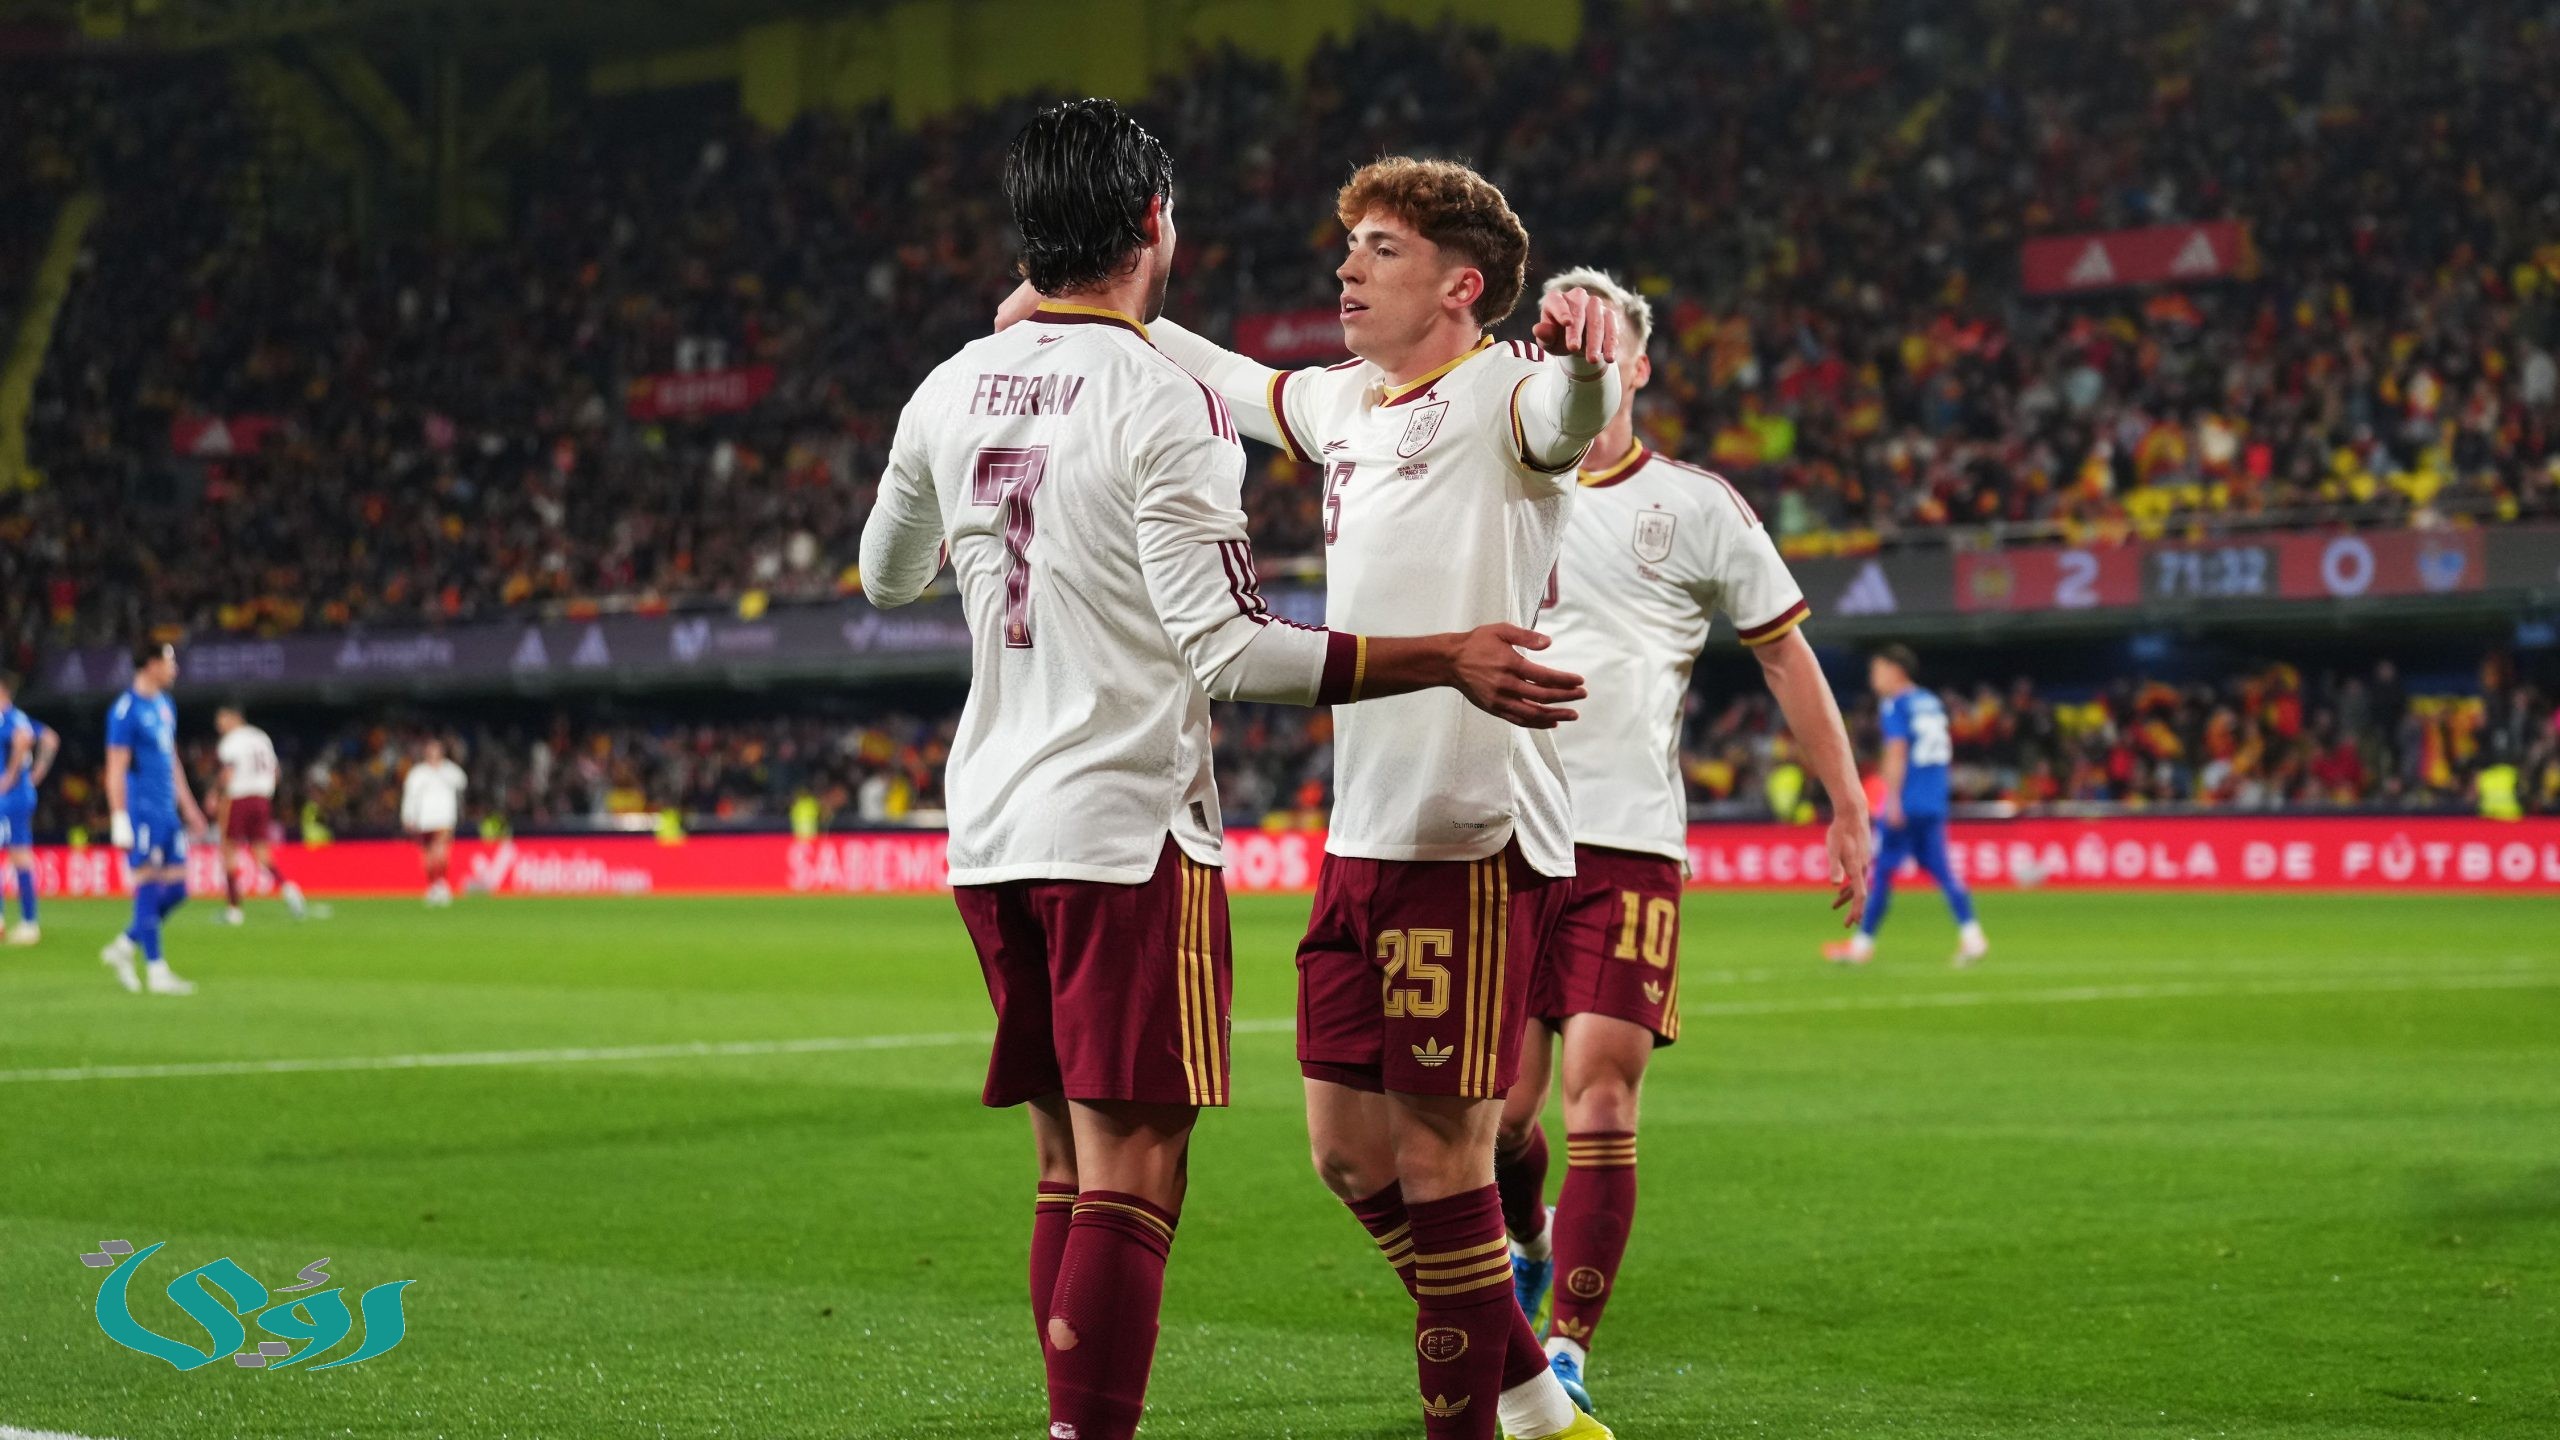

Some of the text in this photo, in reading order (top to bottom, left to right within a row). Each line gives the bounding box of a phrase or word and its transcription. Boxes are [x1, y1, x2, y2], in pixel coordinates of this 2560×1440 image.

[969, 373, 1085, 416] FERRAN
[972, 445, 1049, 649] 7
[2319, 536, 2376, 597] 0
[2054, 549, 2099, 608] 2
[788, 837, 948, 891] SABEM
[2242, 840, 2316, 881] DE
[1614, 890, 1676, 969] 10
[1376, 928, 1453, 1018] 25
